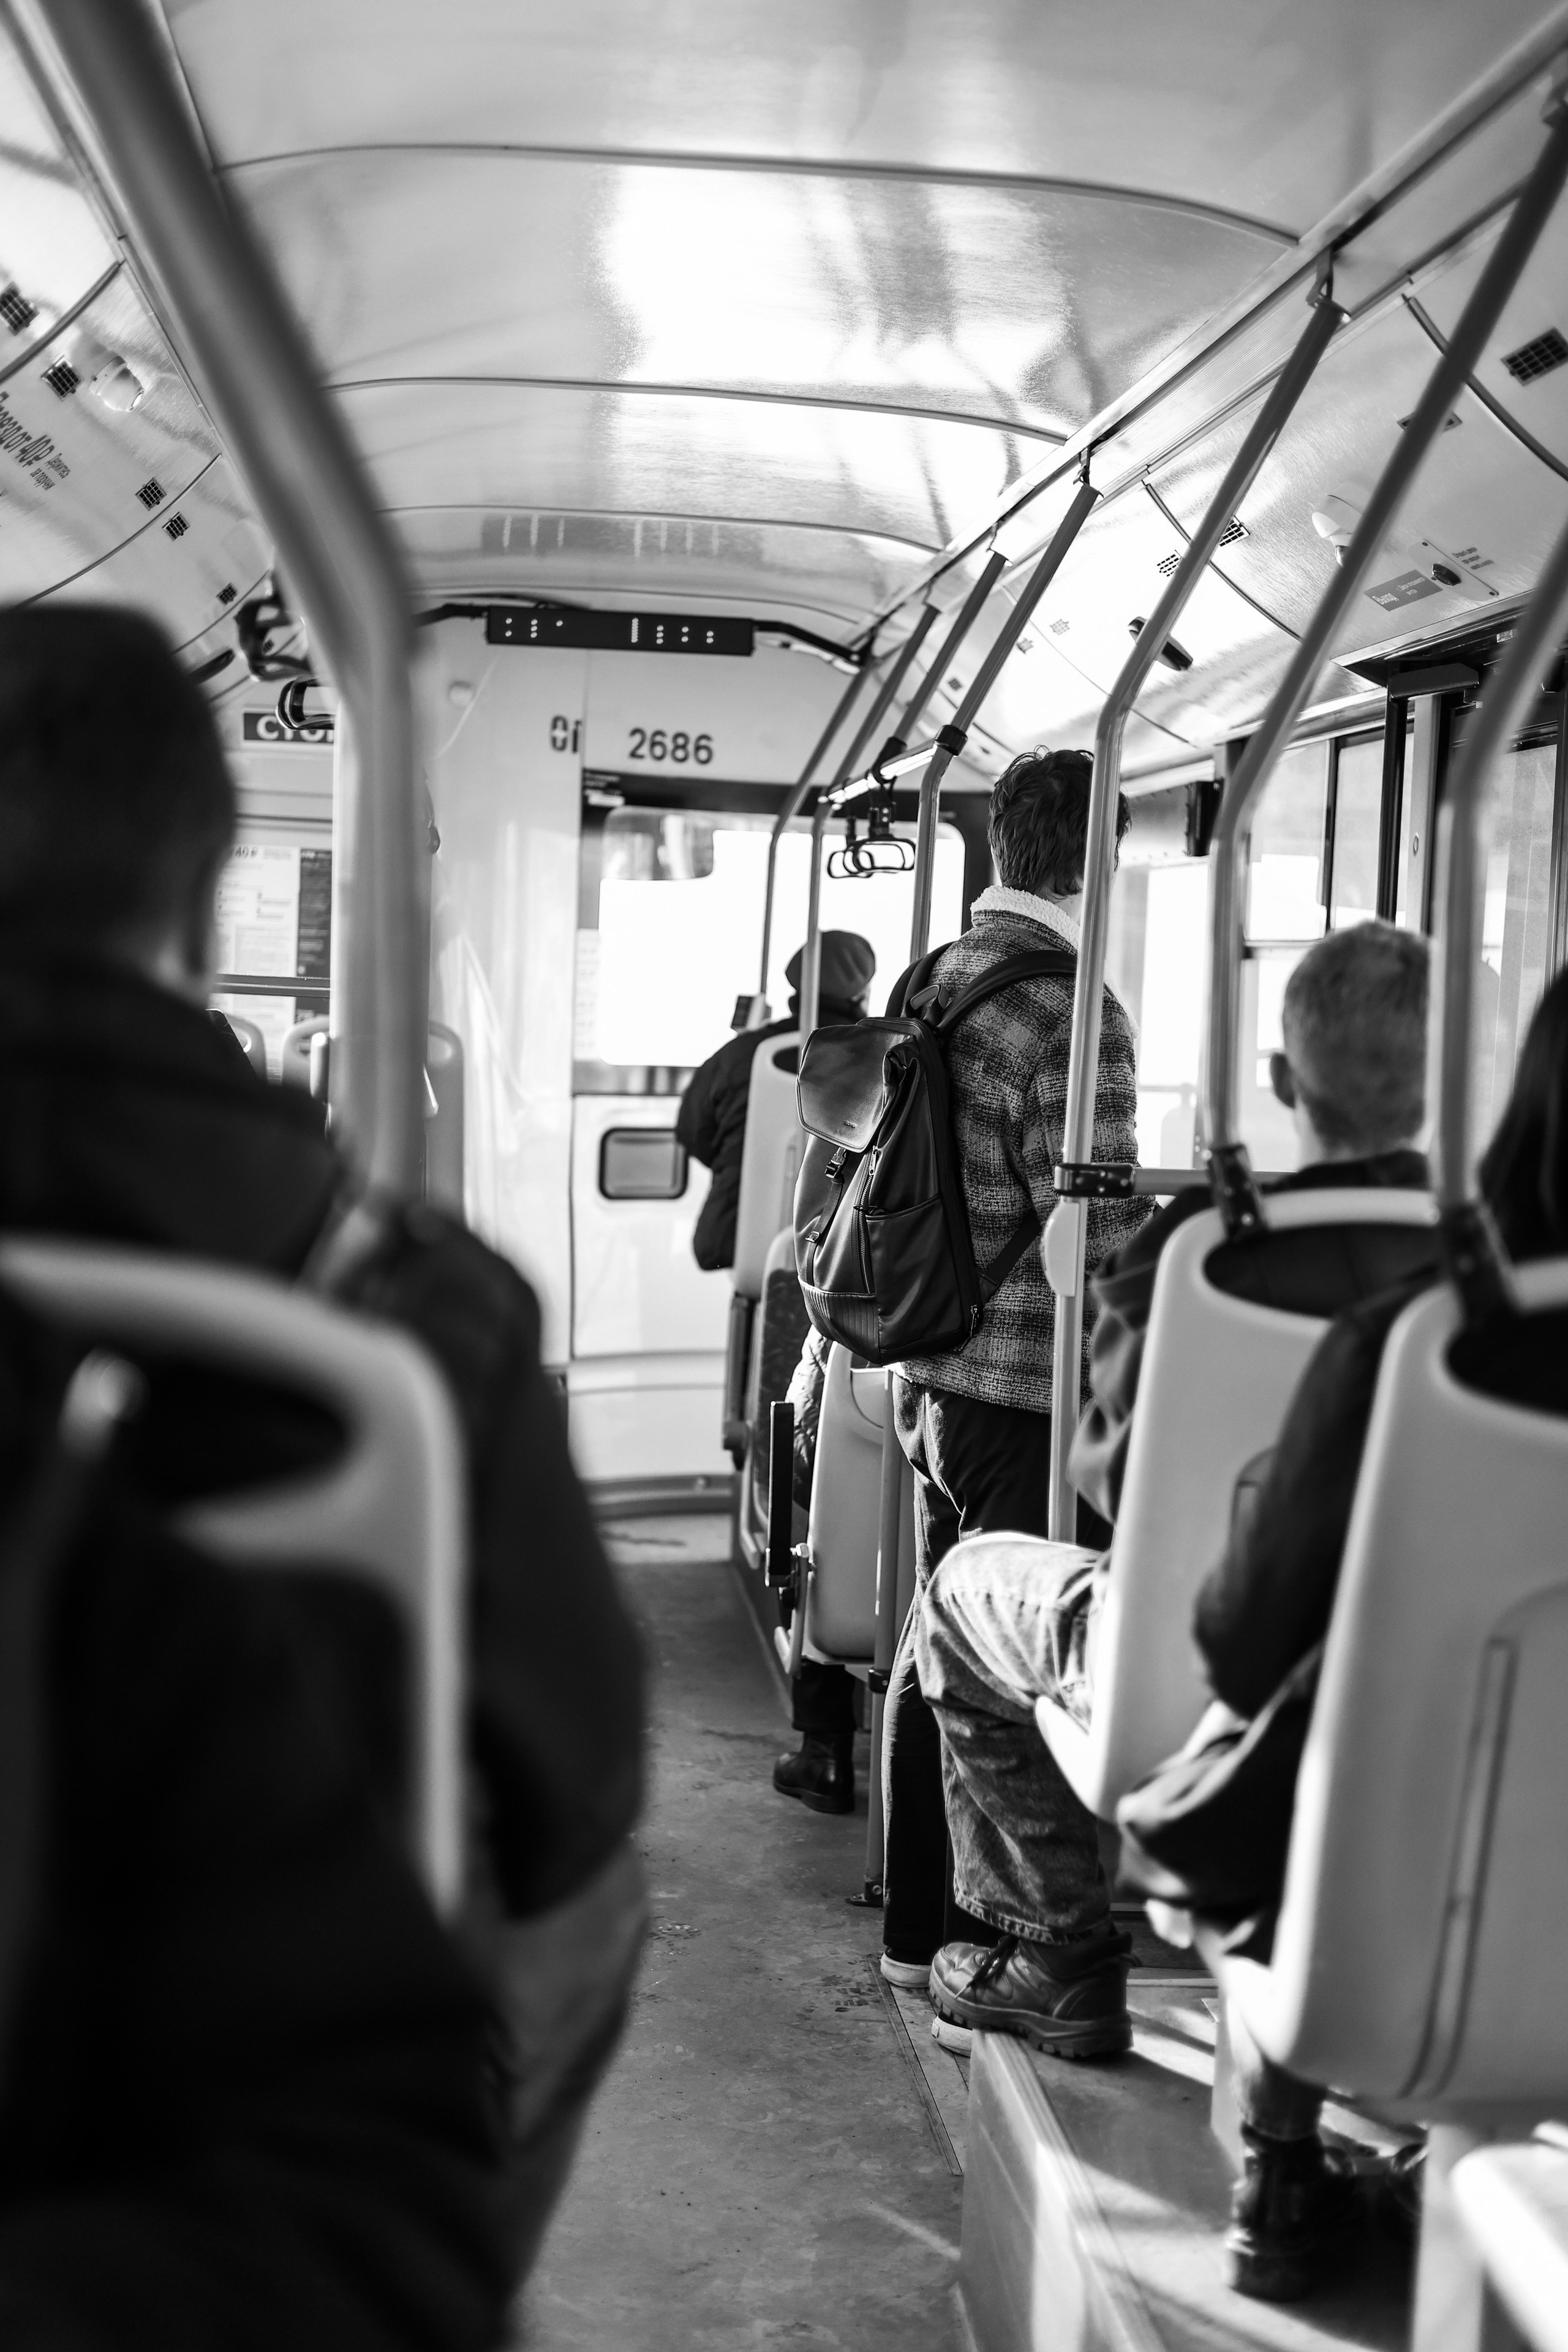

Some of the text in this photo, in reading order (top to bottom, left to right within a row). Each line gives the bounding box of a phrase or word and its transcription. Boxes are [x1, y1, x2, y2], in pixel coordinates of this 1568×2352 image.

[44, 453, 71, 479] Держитесь
[34, 472, 56, 491] поручни
[1371, 592, 1400, 605] Выход
[628, 727, 714, 765] 2686
